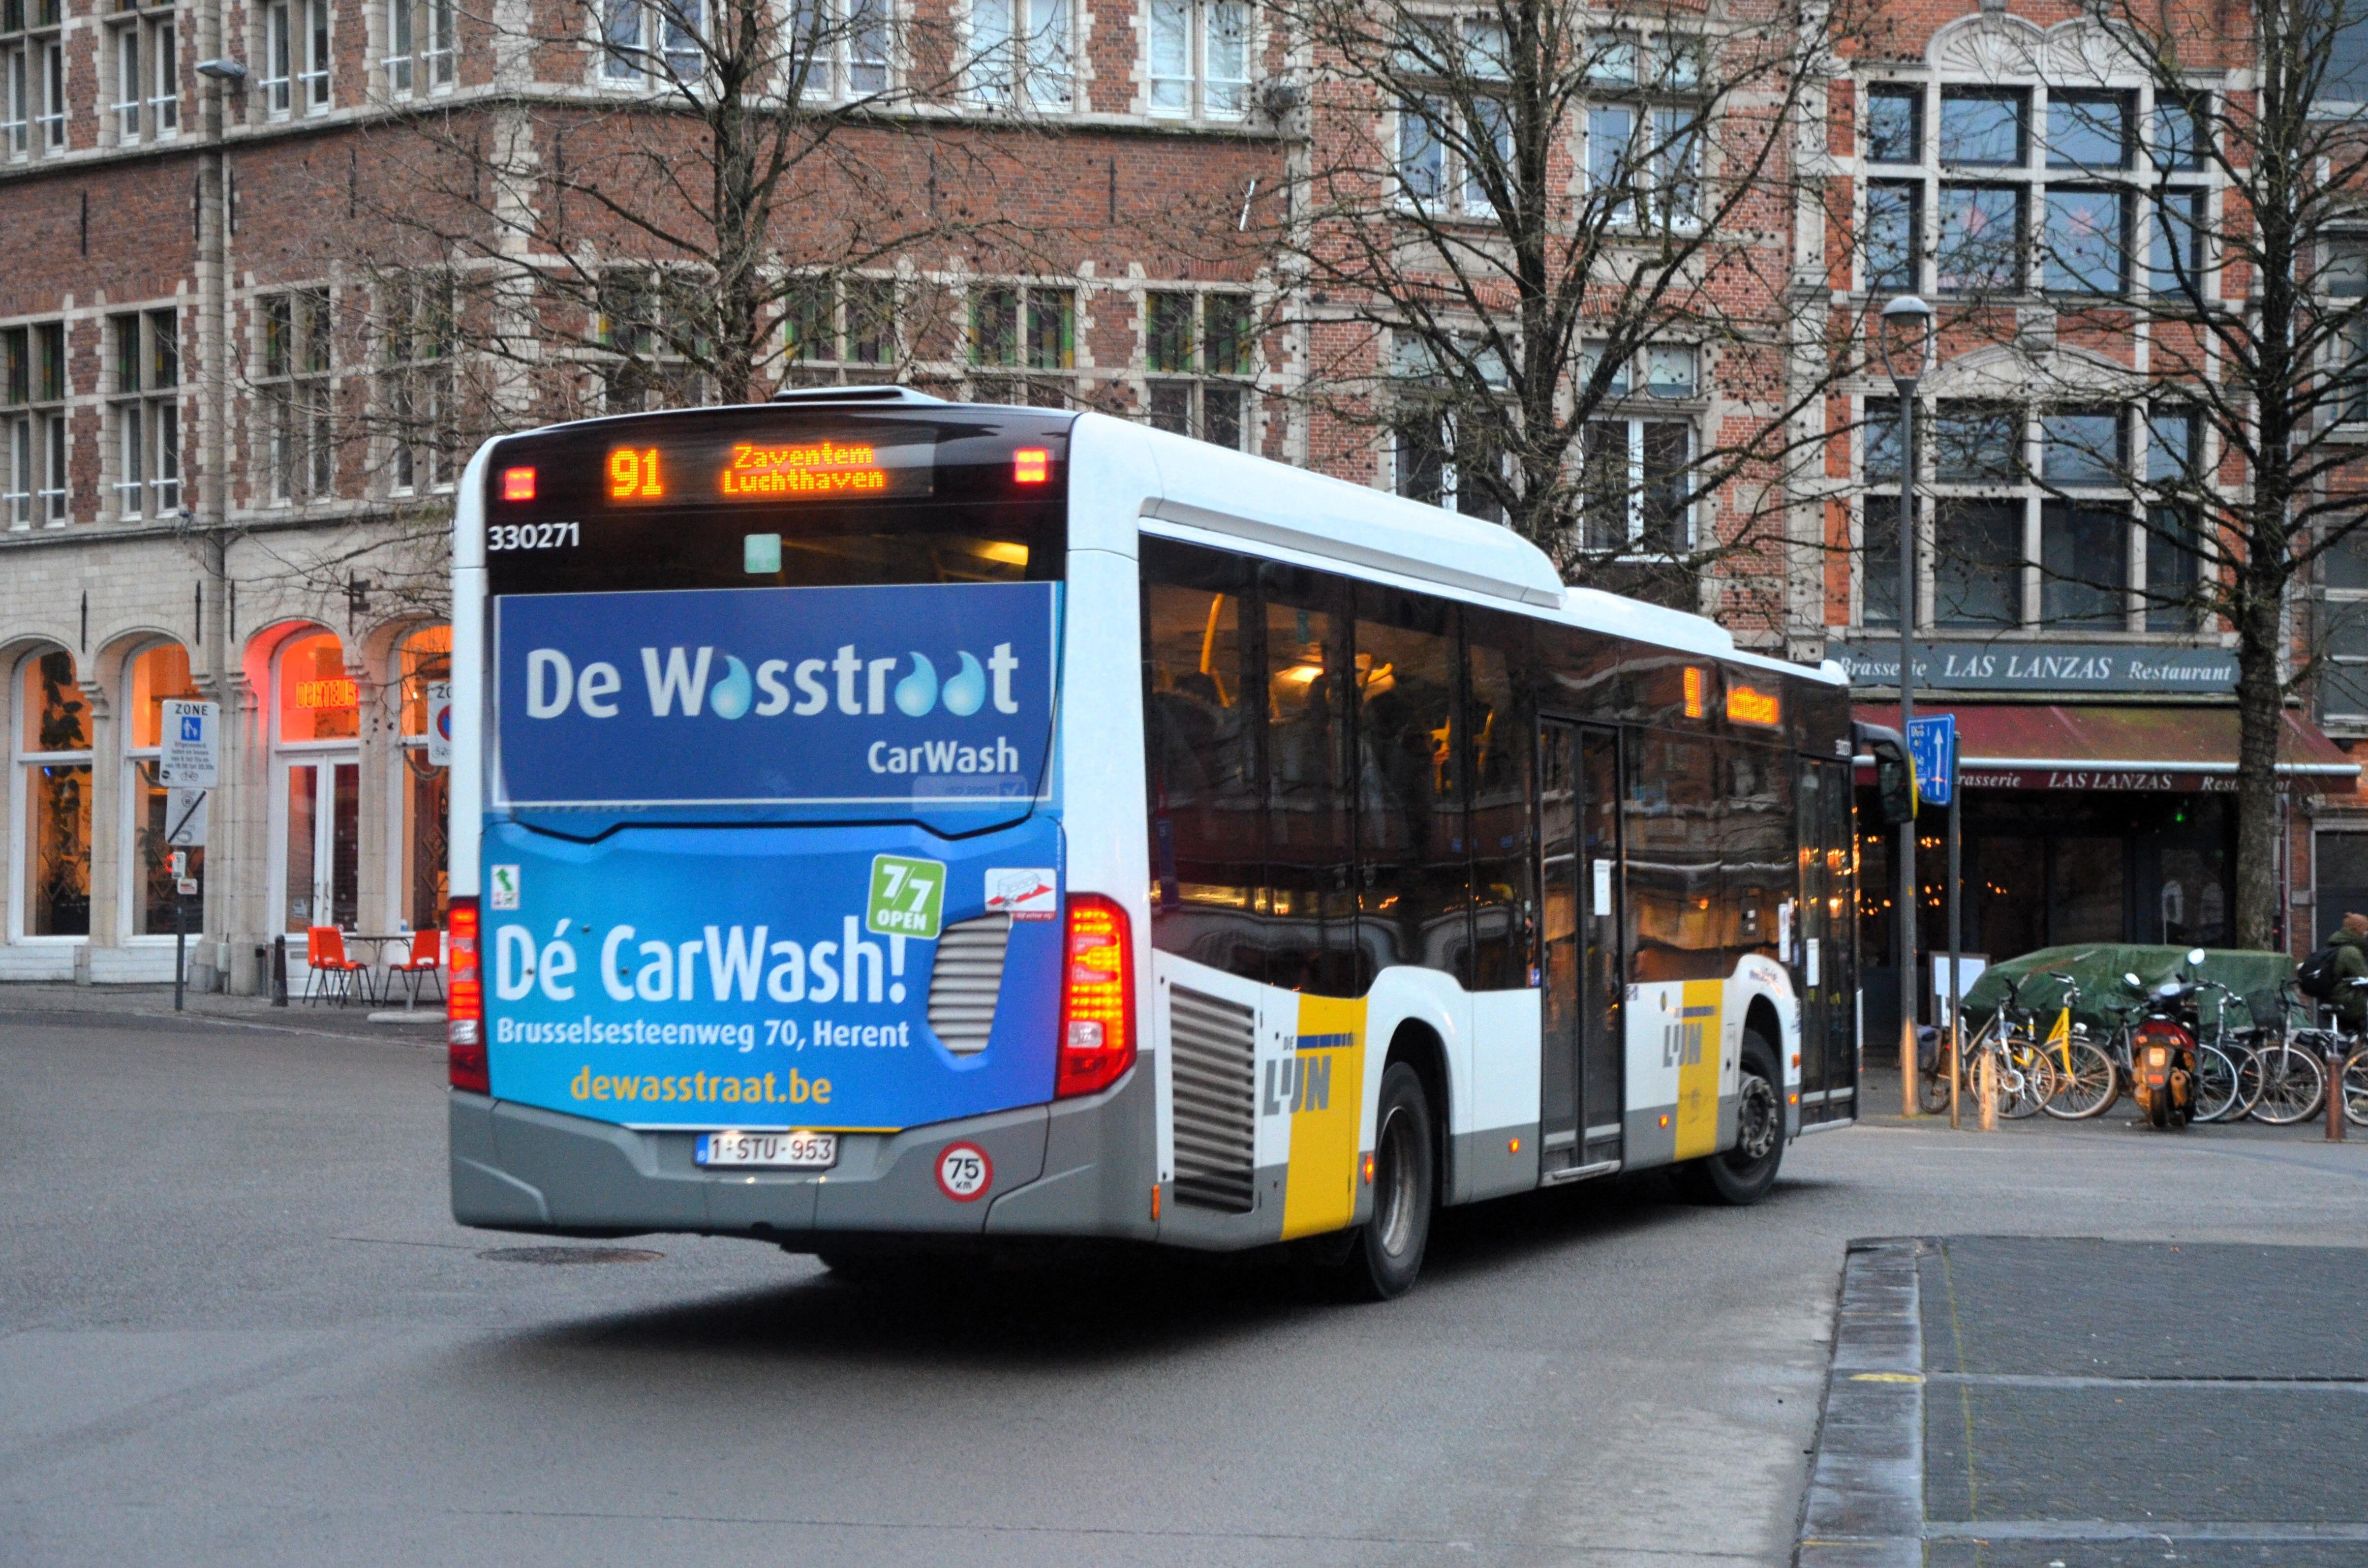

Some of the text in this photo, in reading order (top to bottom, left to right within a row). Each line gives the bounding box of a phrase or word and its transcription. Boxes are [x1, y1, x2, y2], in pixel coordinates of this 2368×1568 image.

[735, 443, 872, 468] Zaventem
[612, 450, 661, 496] 91
[724, 468, 883, 492] Luchthaven
[488, 521, 580, 550] 330271
[1839, 655, 2232, 681] Brasseie LAS LANZAS Restaurant
[526, 648, 621, 718] De
[175, 704, 209, 716] ZONE
[867, 736, 1019, 773] CarWash
[1958, 772, 2021, 787] rasserie
[2049, 772, 2088, 788] LAS
[2092, 773, 2173, 790] LANZAS
[882, 865, 934, 913] 7/7
[876, 909, 927, 930] OPEN
[496, 915, 907, 1004] Dé CarWash!
[497, 1016, 910, 1053] Brusselsesteenweg 70, Herent
[570, 1065, 832, 1104] dewasstraat.be
[948, 1158, 979, 1180] 75
